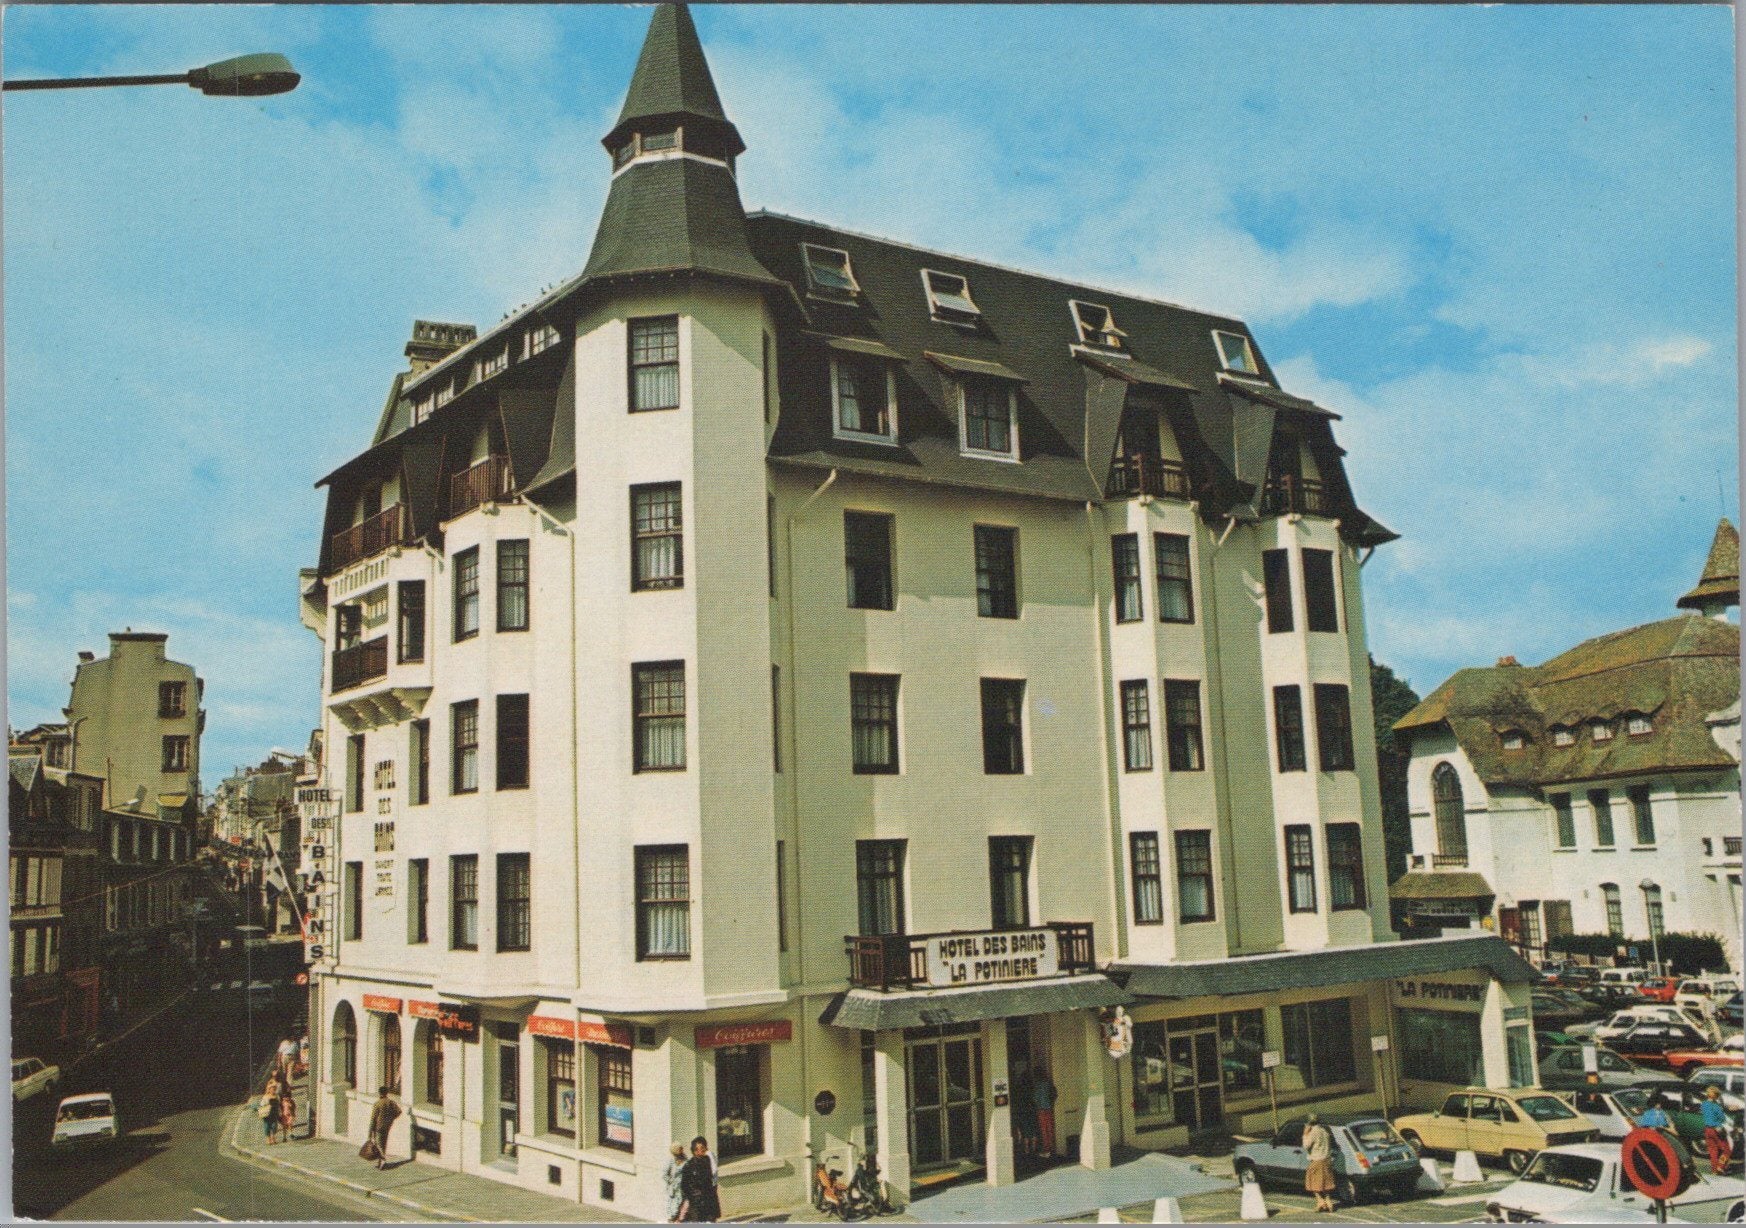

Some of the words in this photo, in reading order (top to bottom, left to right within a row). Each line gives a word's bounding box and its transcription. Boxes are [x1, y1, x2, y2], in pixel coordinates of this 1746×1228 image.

[298, 789, 332, 802] HOTEL
[310, 844, 326, 959] BAINS
[939, 938, 979, 958] HOTEL
[983, 936, 1007, 956] DES
[1011, 933, 1046, 953] BAINS
